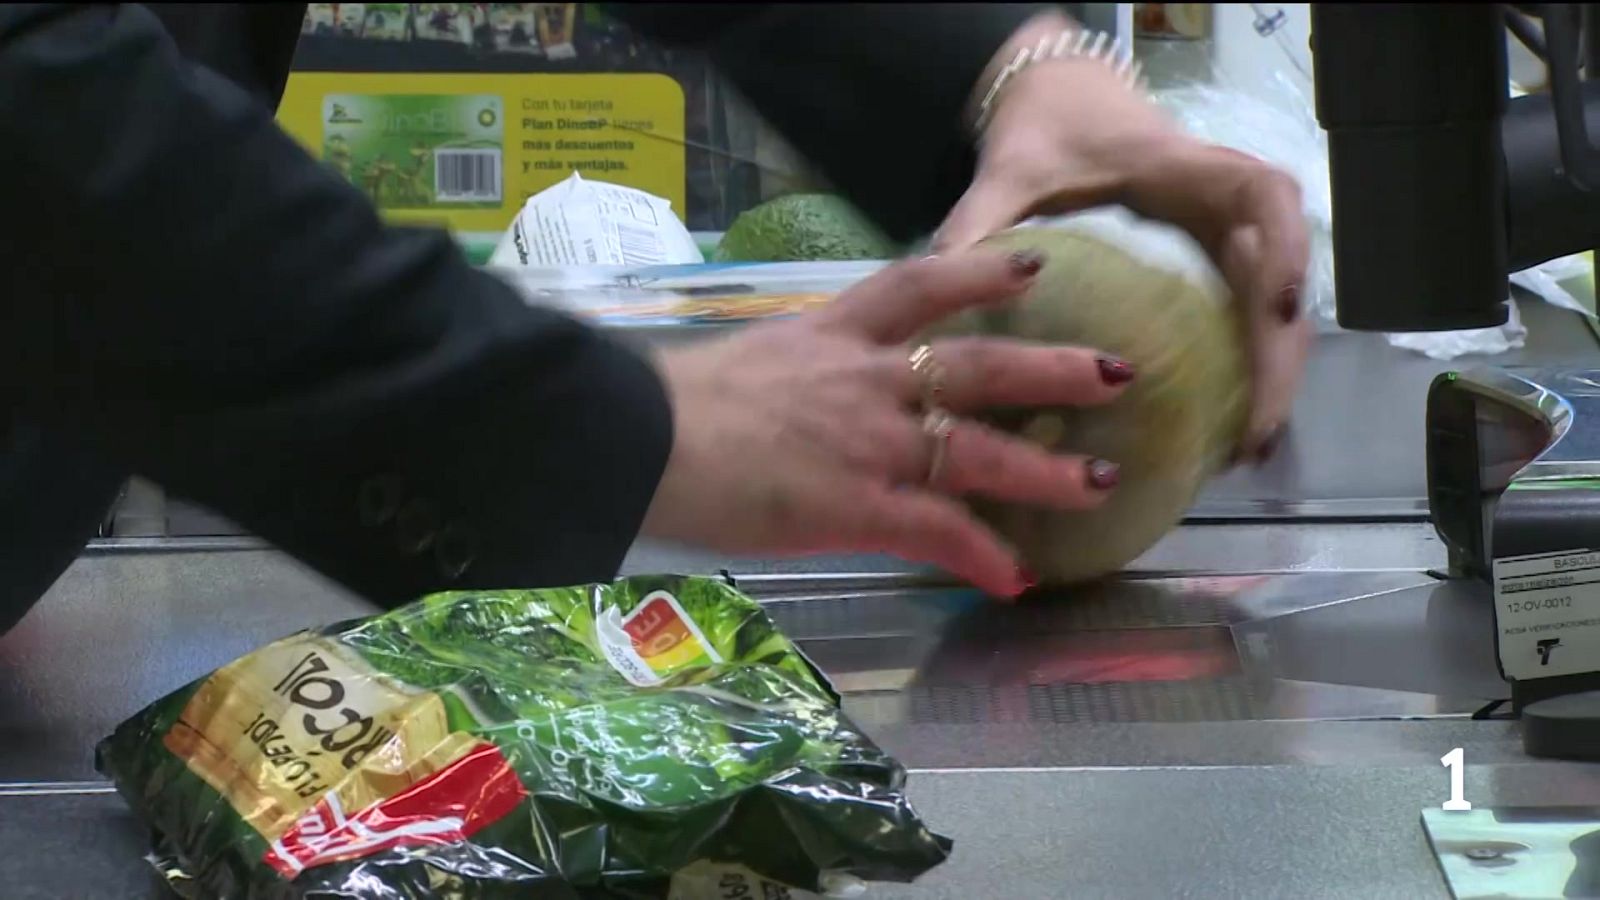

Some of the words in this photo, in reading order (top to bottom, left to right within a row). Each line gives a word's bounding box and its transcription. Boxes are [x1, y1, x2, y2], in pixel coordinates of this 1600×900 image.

[521, 98, 549, 111] Con
[553, 98, 567, 111] tu
[570, 98, 614, 113] tarjeta
[522, 118, 553, 130] Plan
[555, 138, 635, 150] descuentos
[522, 161, 531, 173] y
[534, 157, 563, 170] más
